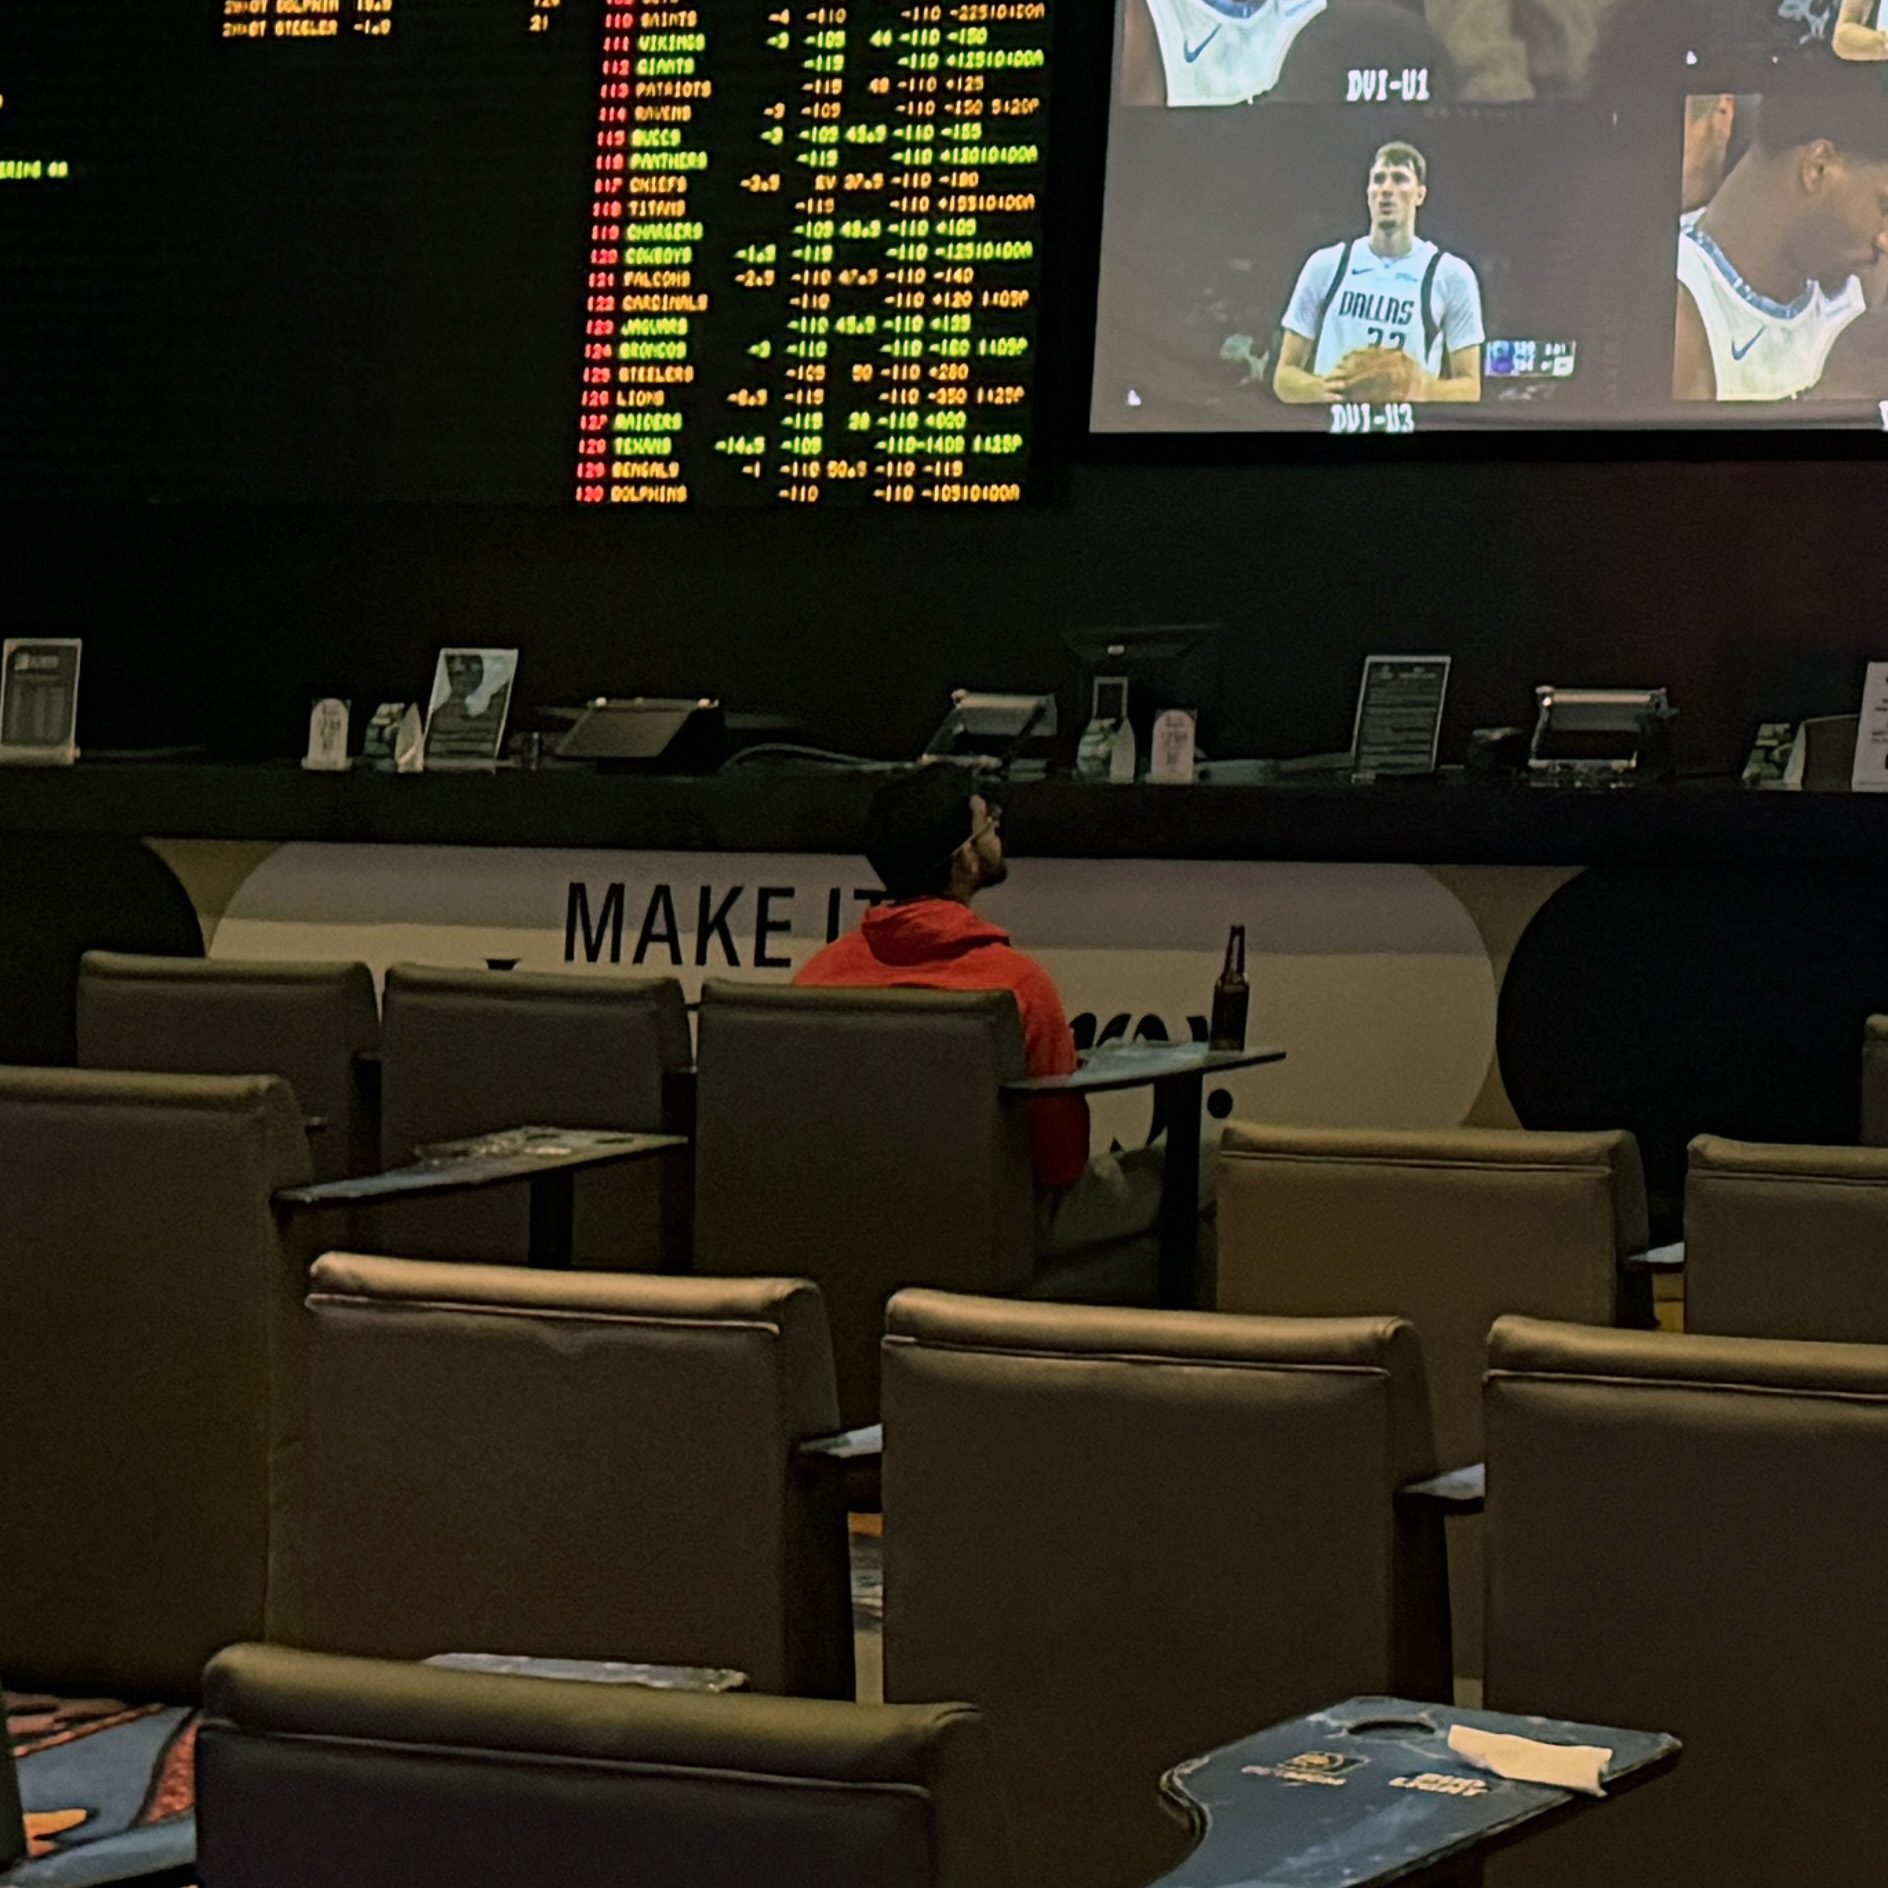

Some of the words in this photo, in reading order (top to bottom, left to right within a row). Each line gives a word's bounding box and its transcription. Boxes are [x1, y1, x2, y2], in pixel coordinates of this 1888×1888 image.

[1347, 67, 1430, 102] DVI-U1
[1339, 290, 1415, 324] DALLAS
[1330, 403, 1414, 433] DVI-U3
[565, 882, 795, 967] MAKE
